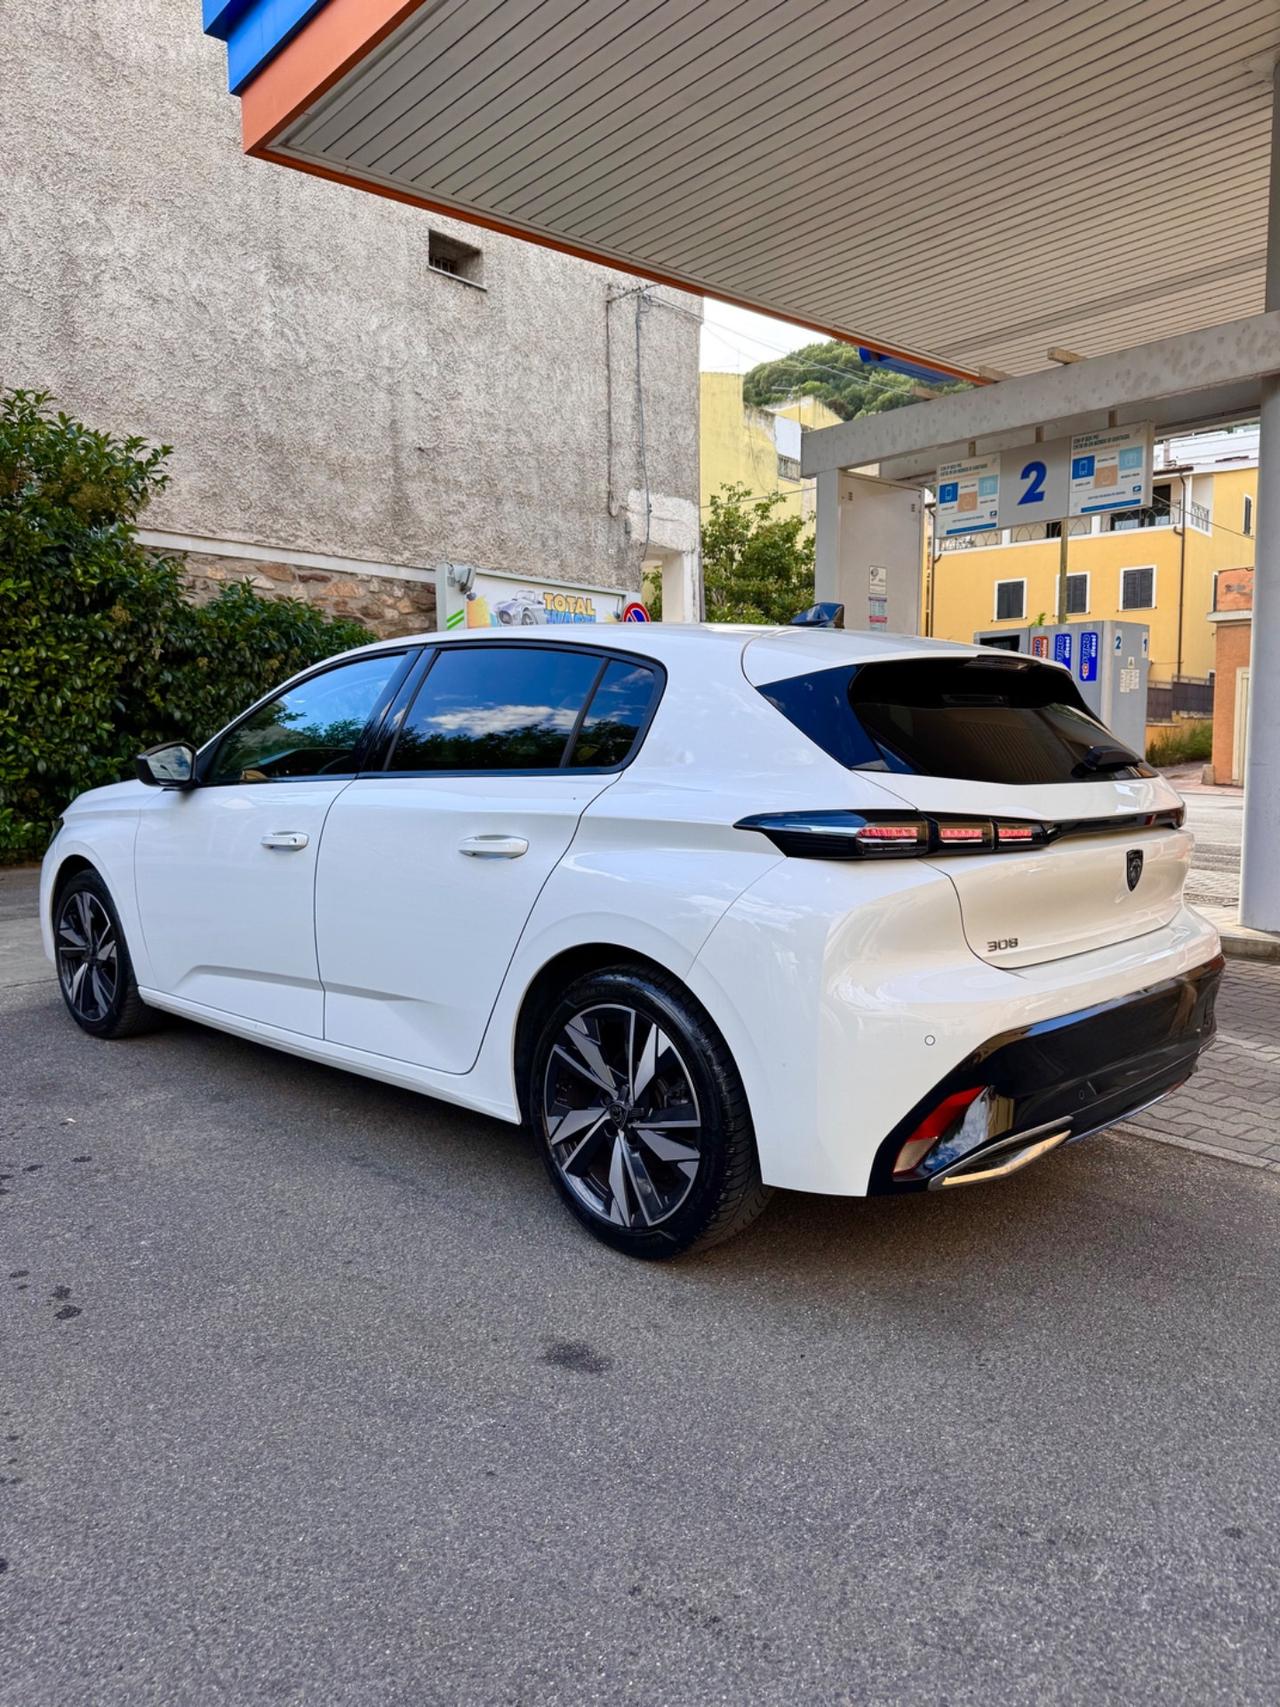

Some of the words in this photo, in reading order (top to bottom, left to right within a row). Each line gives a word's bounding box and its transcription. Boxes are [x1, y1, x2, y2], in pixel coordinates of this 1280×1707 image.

[1017, 461, 1047, 506] 2
[544, 592, 596, 615] TOTAL
[1115, 636, 1121, 649] 2
[1143, 639, 1147, 652] 1
[987, 938, 1018, 952] 308
